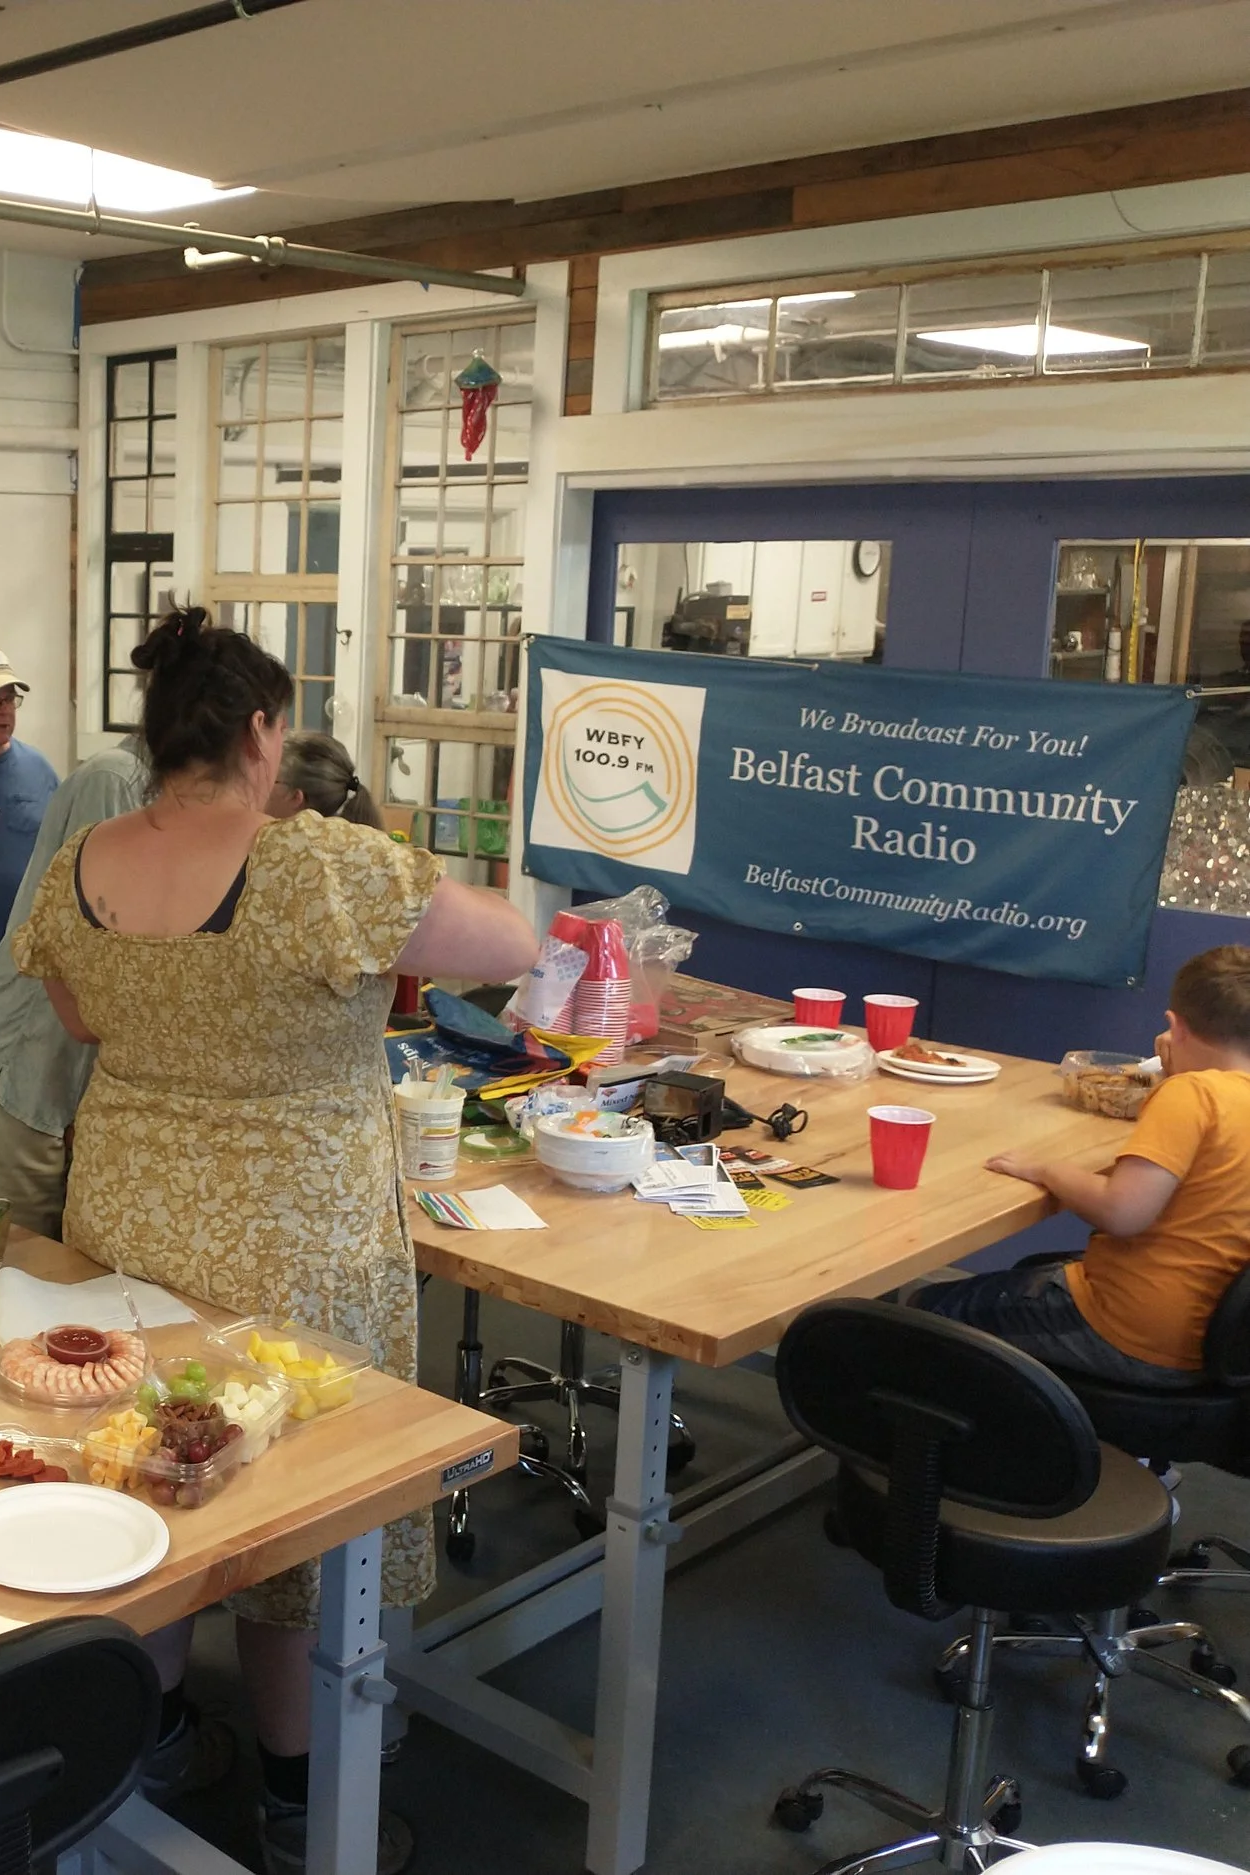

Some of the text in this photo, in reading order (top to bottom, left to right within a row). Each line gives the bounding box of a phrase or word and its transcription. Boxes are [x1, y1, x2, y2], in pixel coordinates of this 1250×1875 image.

[586, 728, 645, 749] WBFY
[799, 707, 1090, 757] We Broadcast For You!
[575, 749, 655, 773] 100.9 FM
[729, 747, 1139, 836] Belfast Community
[851, 815, 977, 865] Radio
[744, 864, 1087, 940] BelfastCommunityRadio.org
